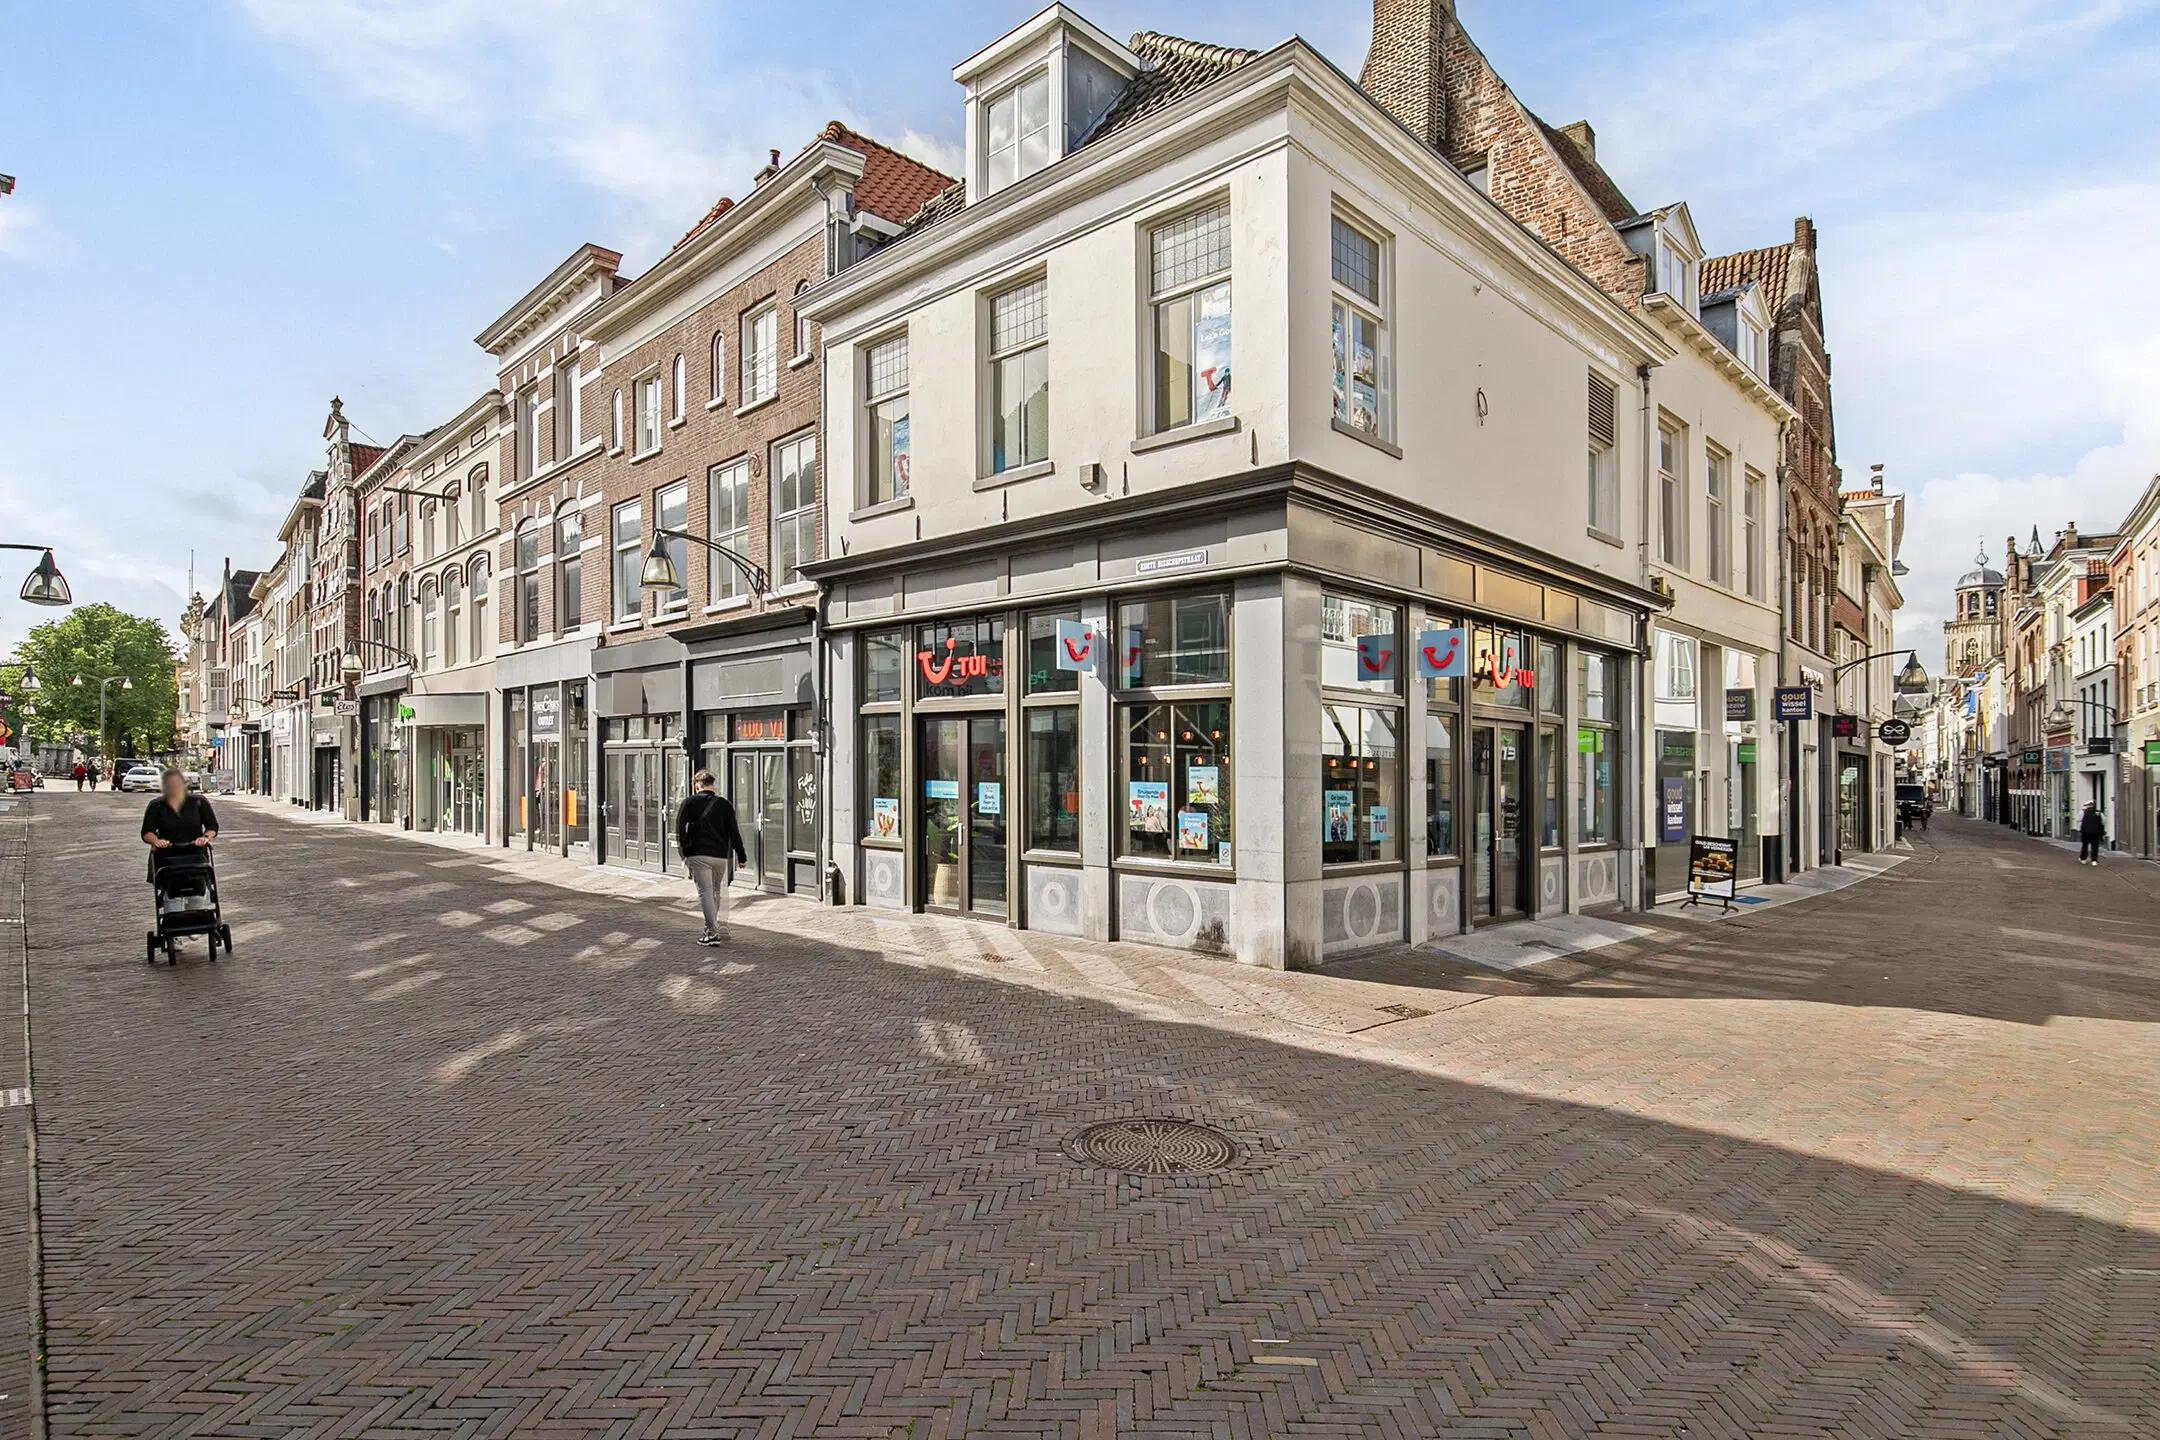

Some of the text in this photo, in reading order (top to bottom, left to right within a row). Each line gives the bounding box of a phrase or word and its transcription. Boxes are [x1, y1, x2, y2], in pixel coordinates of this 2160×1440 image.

[958, 655, 987, 677] TUI
[1781, 692, 1806, 701] goud
[336, 701, 355, 713] Etos
[537, 715, 554, 726] OUTLET
[1667, 786, 1683, 803] goud
[1667, 801, 1683, 813] wissel
[1667, 814, 1683, 825] kantoor
